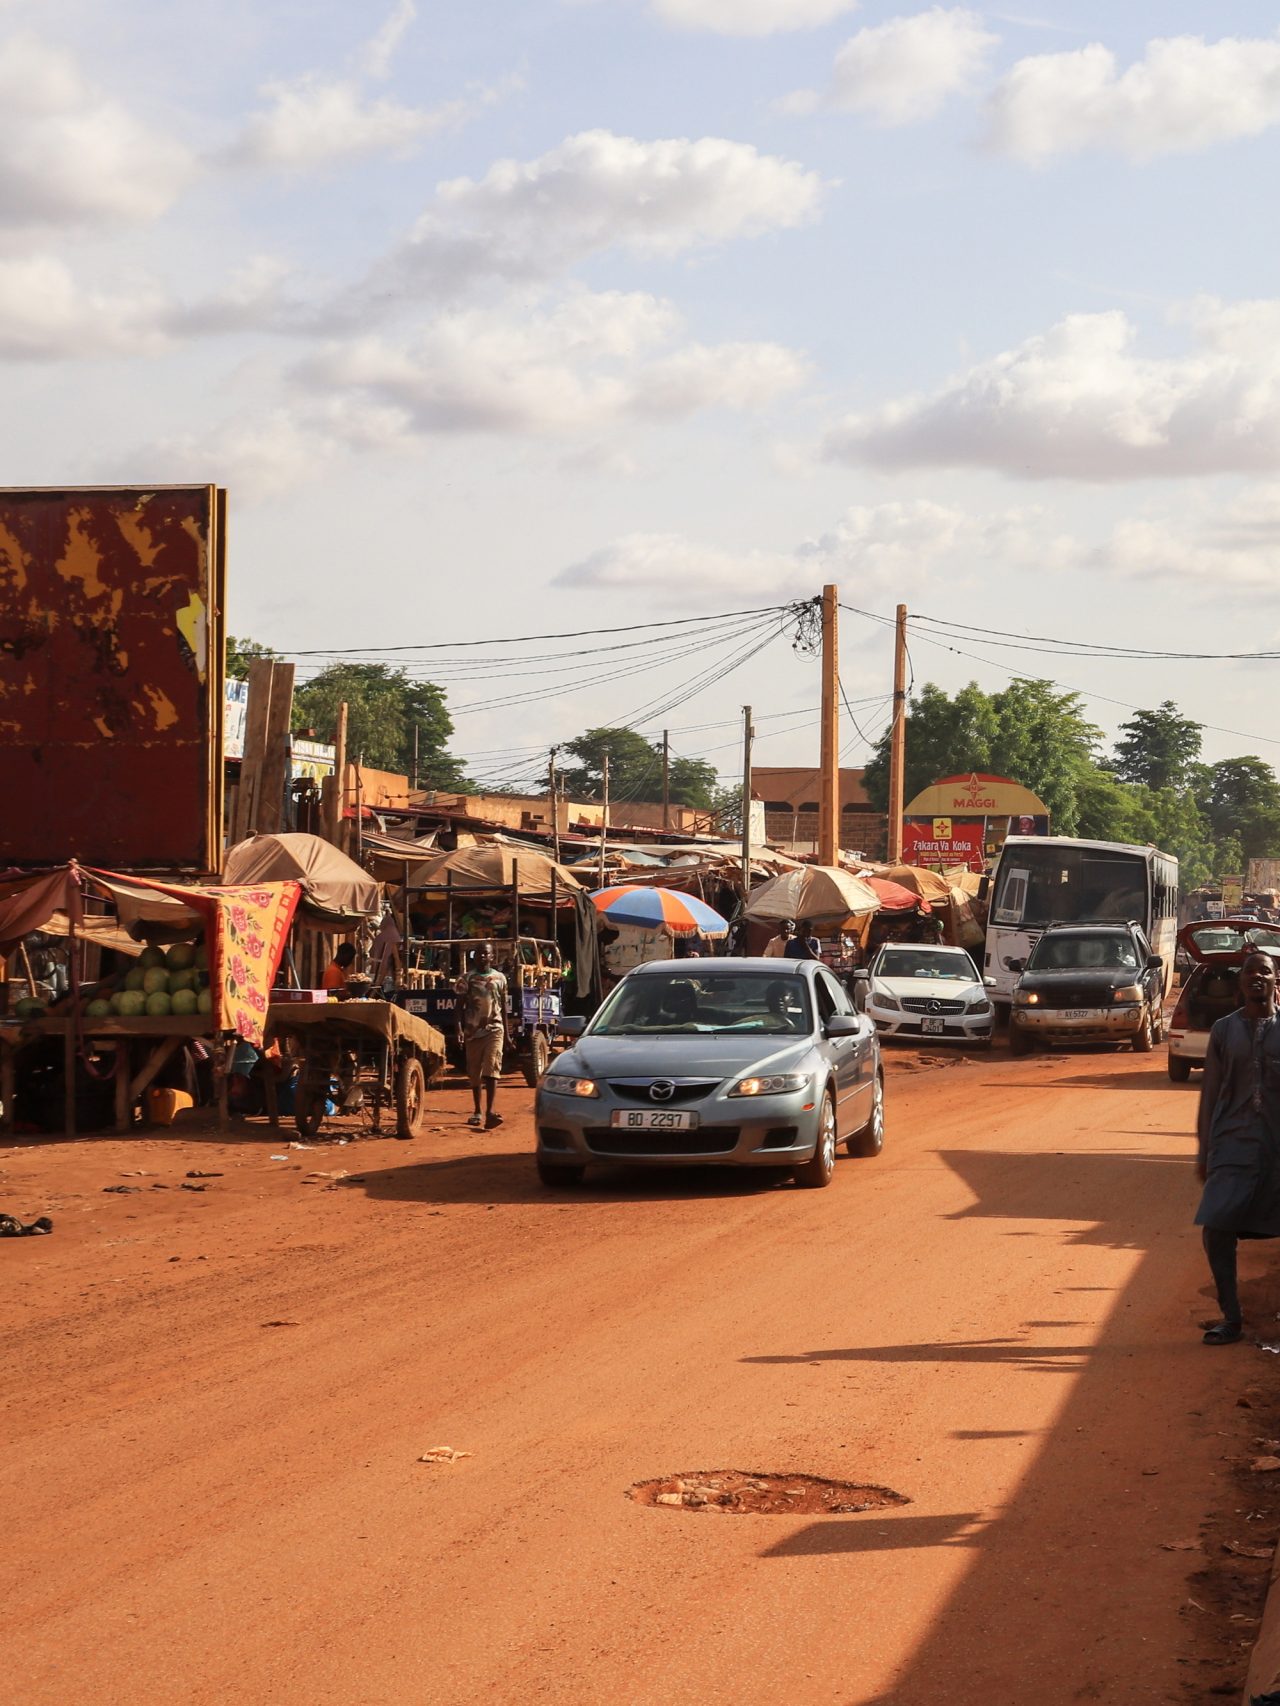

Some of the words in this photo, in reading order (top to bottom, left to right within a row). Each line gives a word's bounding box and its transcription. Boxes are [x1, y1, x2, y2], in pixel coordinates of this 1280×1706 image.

[953, 799, 996, 808] MAGGI
[913, 840, 939, 851] Zakara
[940, 840, 949, 851] Ya
[952, 840, 971, 851] Koka
[650, 1113, 682, 1127] 2297
